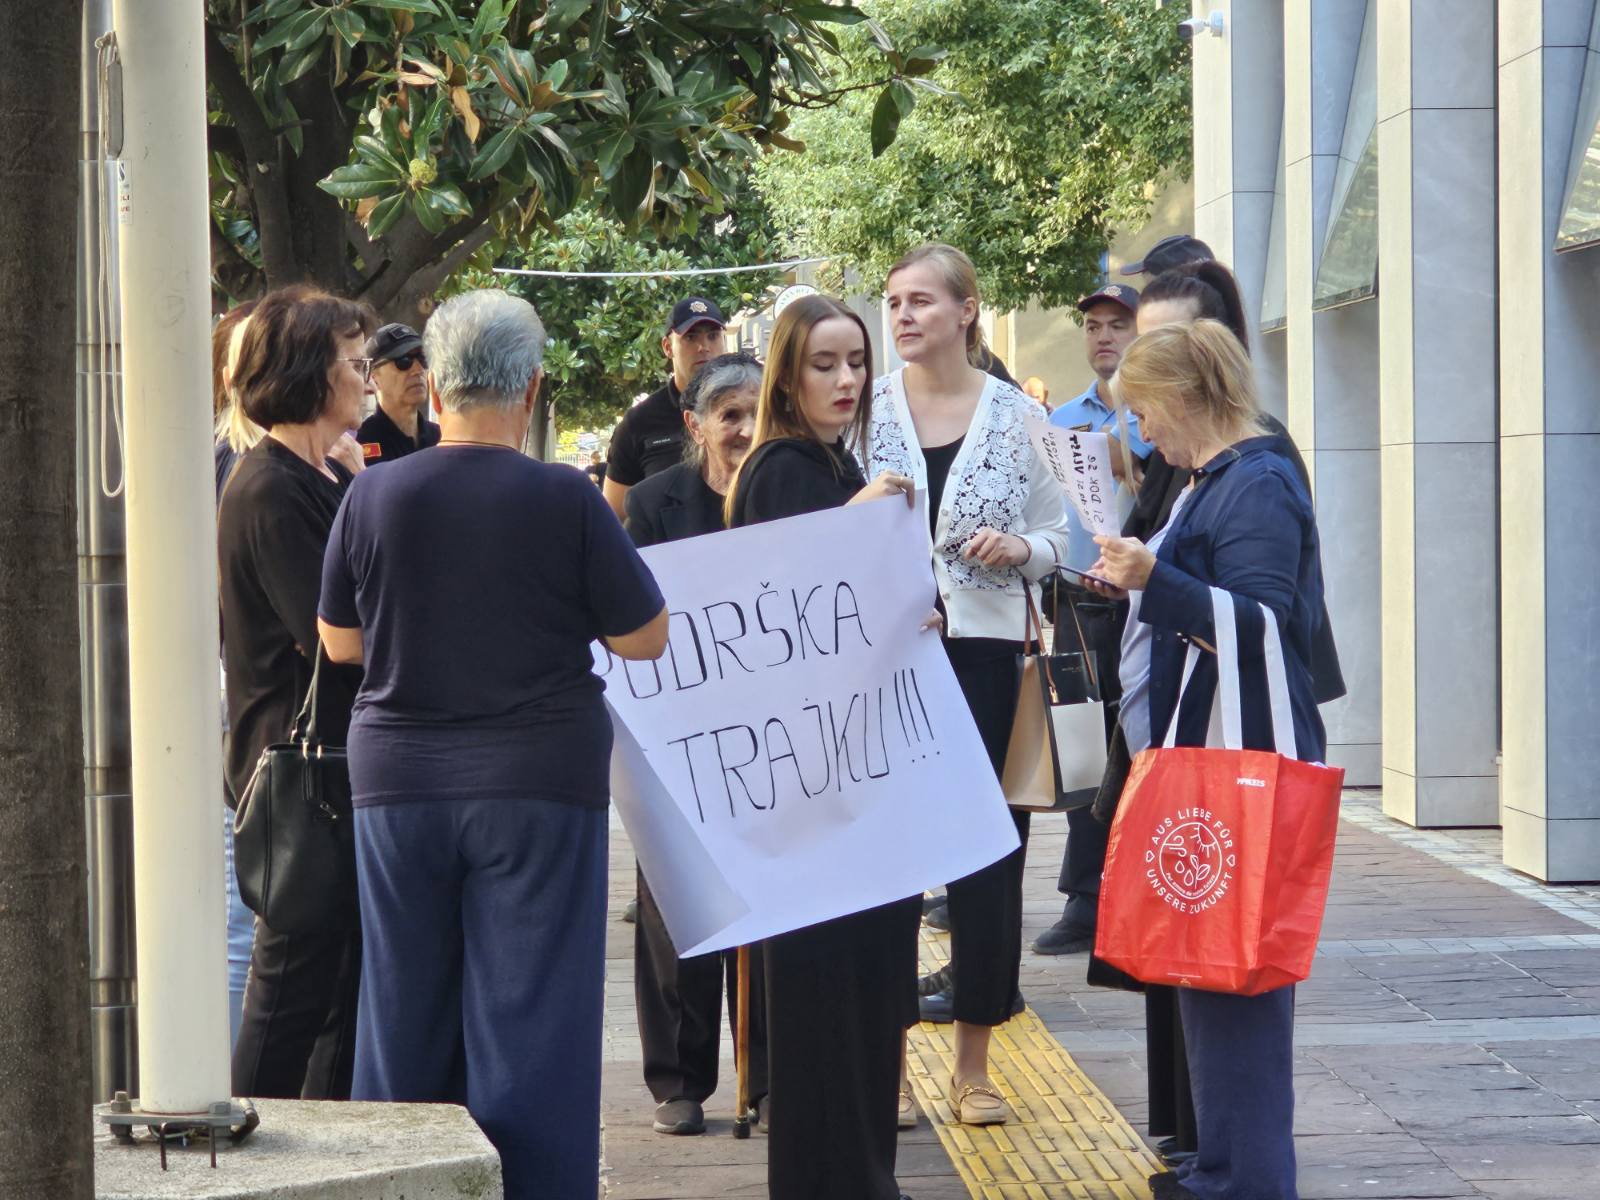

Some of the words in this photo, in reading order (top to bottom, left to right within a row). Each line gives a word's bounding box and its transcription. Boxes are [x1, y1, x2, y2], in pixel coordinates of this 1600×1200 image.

[600, 581, 873, 700] ODRŠKA
[641, 668, 941, 823] TRAJKU!!!
[1152, 817, 1173, 846] AUS
[1178, 807, 1212, 822] LIEBE
[1146, 868, 1187, 913] UNSERE
[1189, 871, 1233, 915] ZUKUNFT
